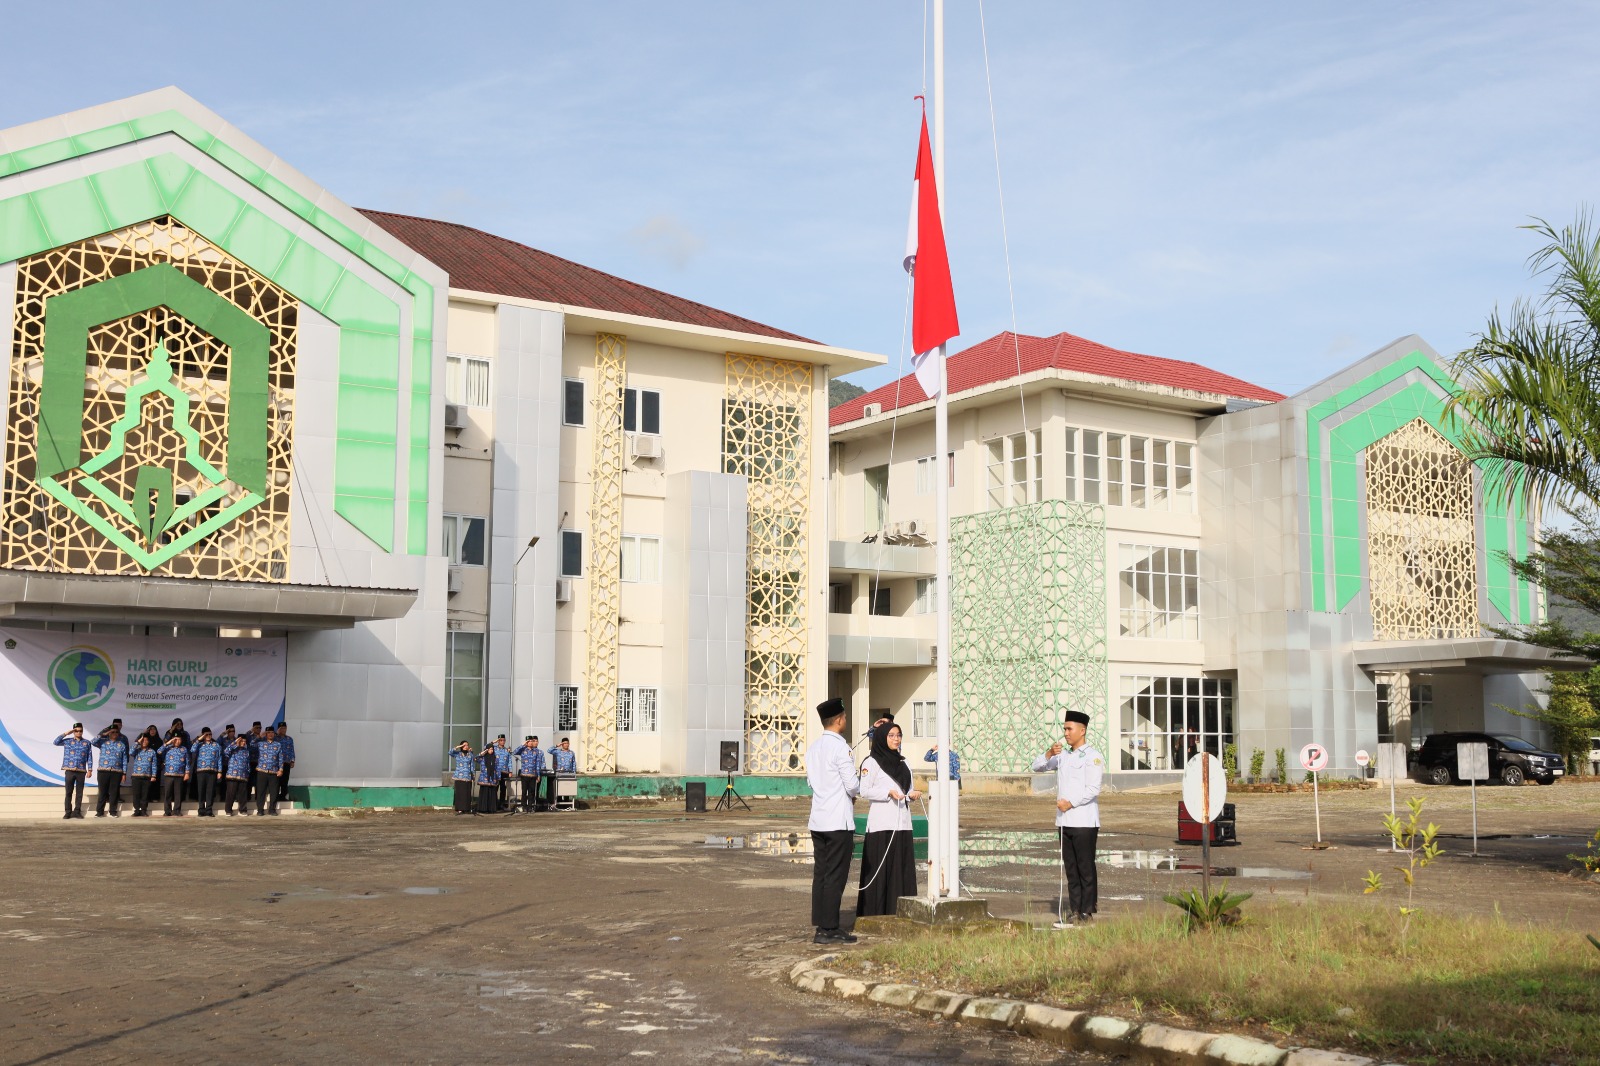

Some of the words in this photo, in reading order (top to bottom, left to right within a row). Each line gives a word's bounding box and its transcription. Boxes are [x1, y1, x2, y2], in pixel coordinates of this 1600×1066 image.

[127, 659, 162, 672] HARI
[167, 660, 208, 673] GURU
[126, 673, 201, 687] NASIONAL
[204, 676, 238, 688] 2025
[126, 692, 159, 700] Merawat
[161, 692, 191, 701] Semesta
[192, 693, 218, 702] dengan
[220, 693, 238, 701] Cinta
[1308, 749, 1321, 766] P
